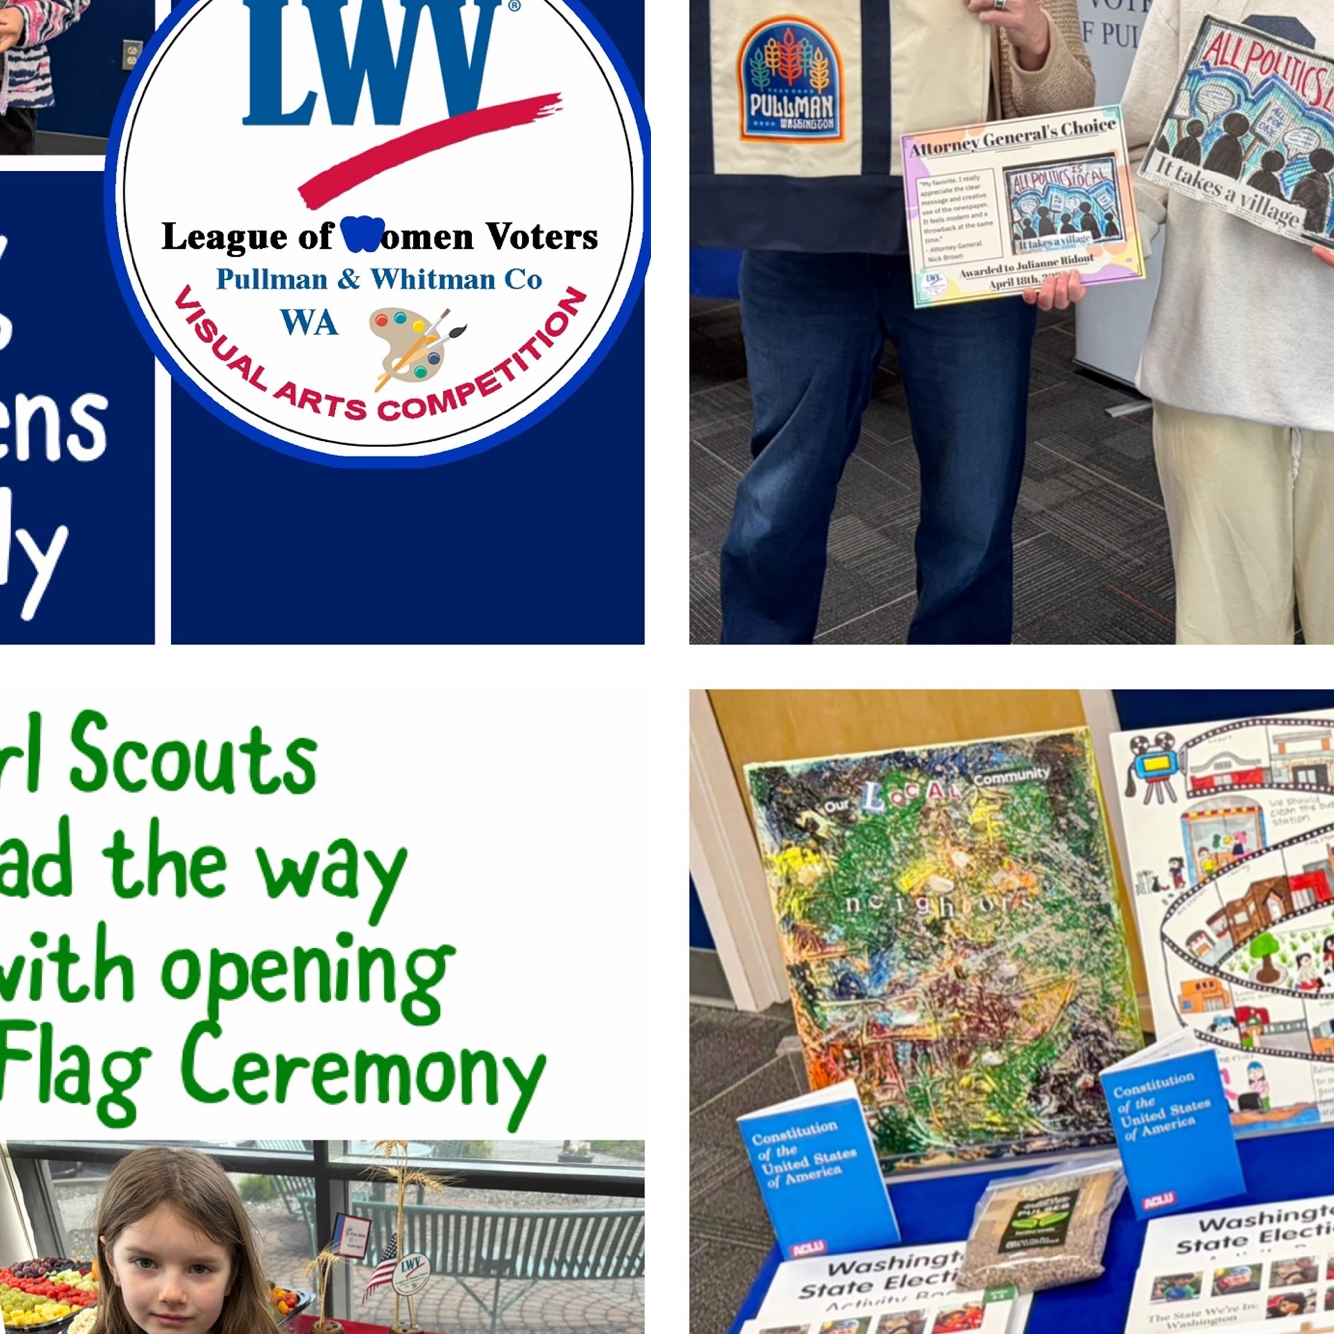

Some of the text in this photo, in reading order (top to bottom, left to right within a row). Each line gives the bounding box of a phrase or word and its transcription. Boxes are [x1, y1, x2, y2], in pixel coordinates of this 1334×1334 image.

[1203, 31, 1245, 68] ALL
[1243, 41, 1328, 106] POLITICS
[749, 93, 833, 119] PULLMAN
[779, 117, 834, 130] WASHINGTON
[909, 118, 1117, 158] Attorney General's Choice
[1154, 155, 1301, 229] It takes a village
[959, 253, 1094, 279] Awarded to Julianne Ridout
[989, 277, 1014, 291] April
[824, 796, 850, 815] Our
[972, 764, 1051, 790] Community
